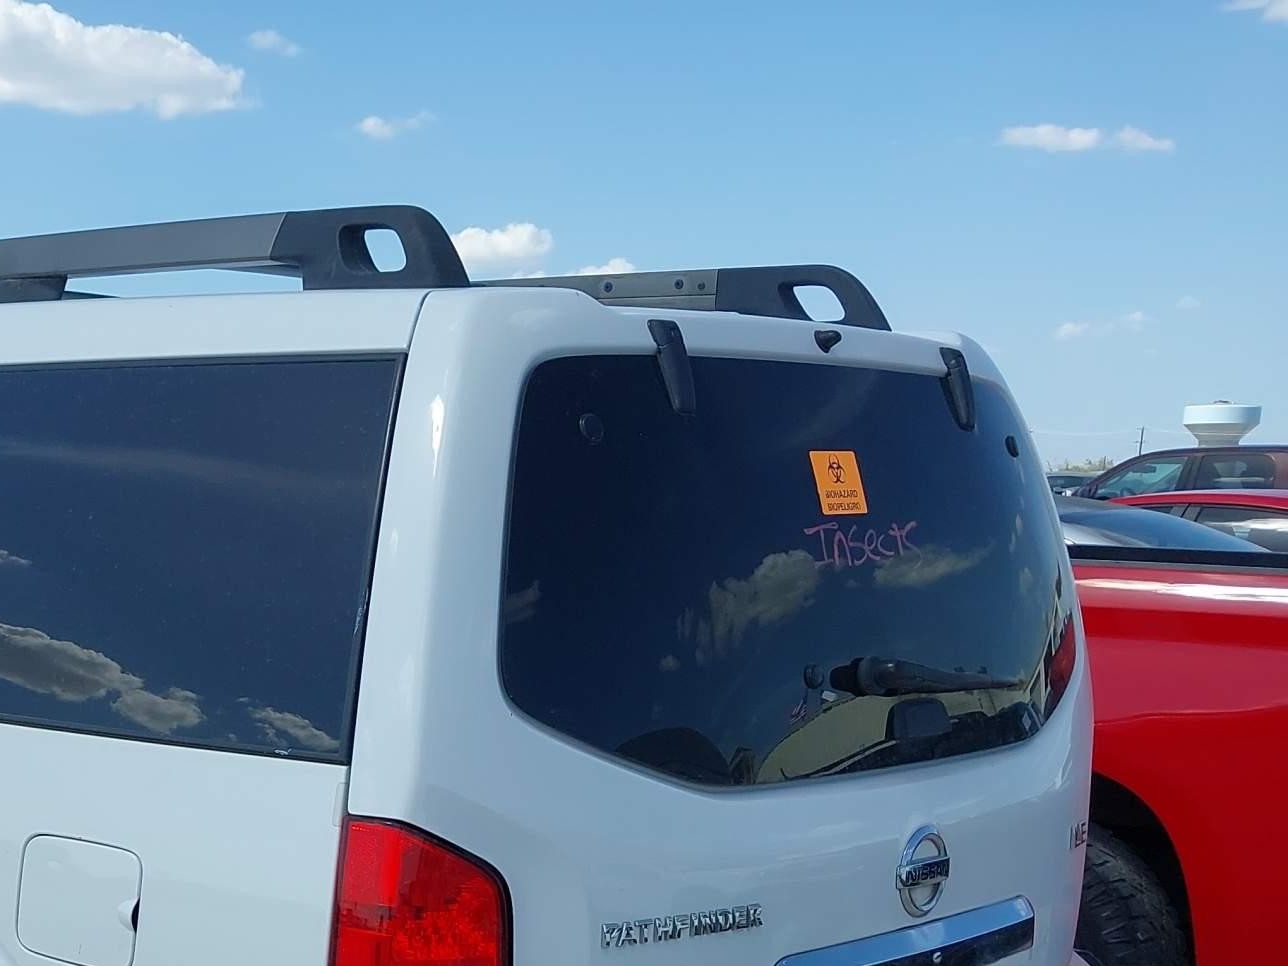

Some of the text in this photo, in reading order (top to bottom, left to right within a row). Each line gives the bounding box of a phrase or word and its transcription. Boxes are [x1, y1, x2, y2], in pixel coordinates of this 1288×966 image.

[825, 490, 858, 499] BIOHAZARD
[827, 502, 861, 511] BIOPELIGRO
[905, 861, 950, 884] NISSAN
[600, 903, 763, 949] PATHFINDER
